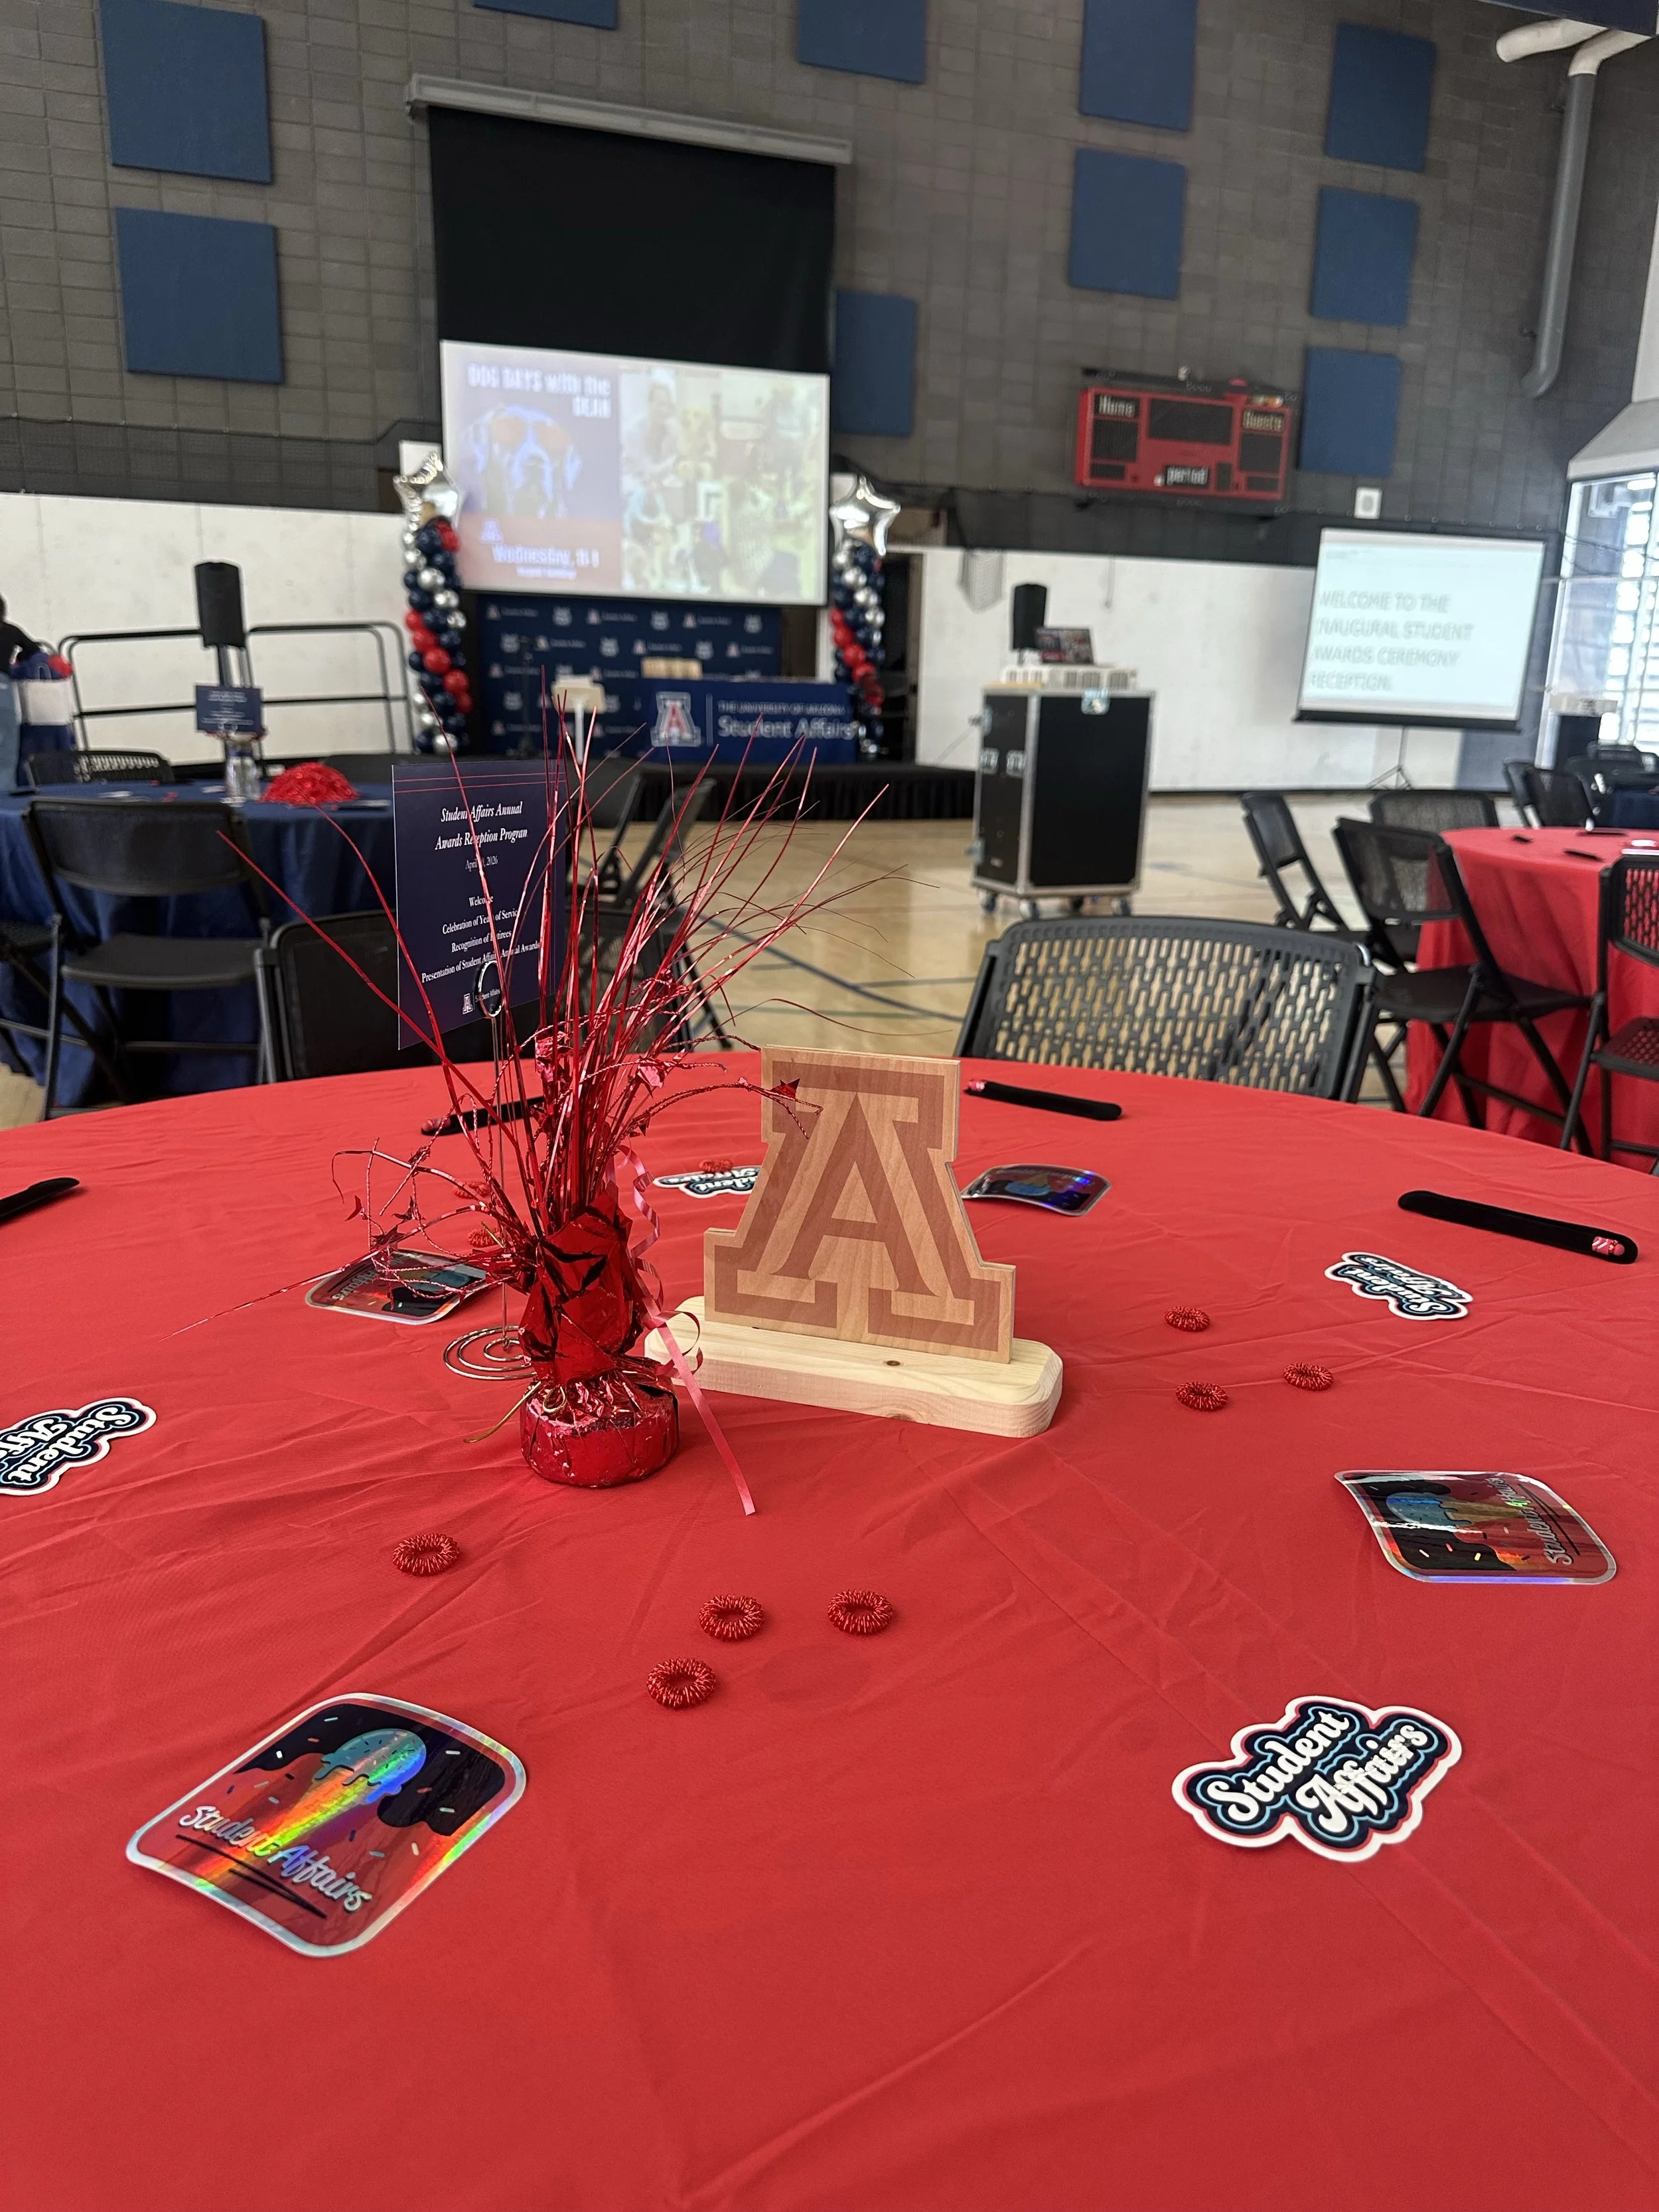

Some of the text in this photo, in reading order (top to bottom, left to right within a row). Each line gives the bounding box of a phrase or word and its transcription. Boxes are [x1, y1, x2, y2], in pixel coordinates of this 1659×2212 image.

[583, 374, 611, 397] the
[1321, 590, 1451, 613] WELCOME TO THE
[1403, 620, 1474, 640] STUDENT
[1376, 646, 1461, 667] CEREMONY
[718, 715, 855, 740] Student Affairs
[441, 800, 523, 822] Studen Affairs Annual
[435, 833, 463, 850] Awards
[464, 829, 498, 848] Reeption
[486, 855, 498, 866] 2026
[469, 896, 494, 907] Welcoe
[443, 919, 472, 934] Celebration
[472, 915, 479, 926] of
[495, 910, 502, 921] of
[502, 907, 519, 920] Servic
[451, 936, 482, 952] Recognition
[483, 932, 490, 944] of
[421, 966, 455, 984] Presentation
[456, 962, 463, 972] of
[463, 956, 482, 970] Student
[521, 940, 540, 953] Awards
[695, 1175, 758, 1191] udent
[715, 1061, 1001, 1353] A
[1360, 1256, 1453, 1296] Affairs
[1344, 1267, 1448, 1313] Student
[8, 1406, 132, 1481] Student
[1485, 1477, 1573, 1566] Student Affairs
[1206, 1710, 1350, 1822] Student
[1295, 1724, 1429, 1834] Affairs
[179, 1805, 373, 1913] Student Affairs
